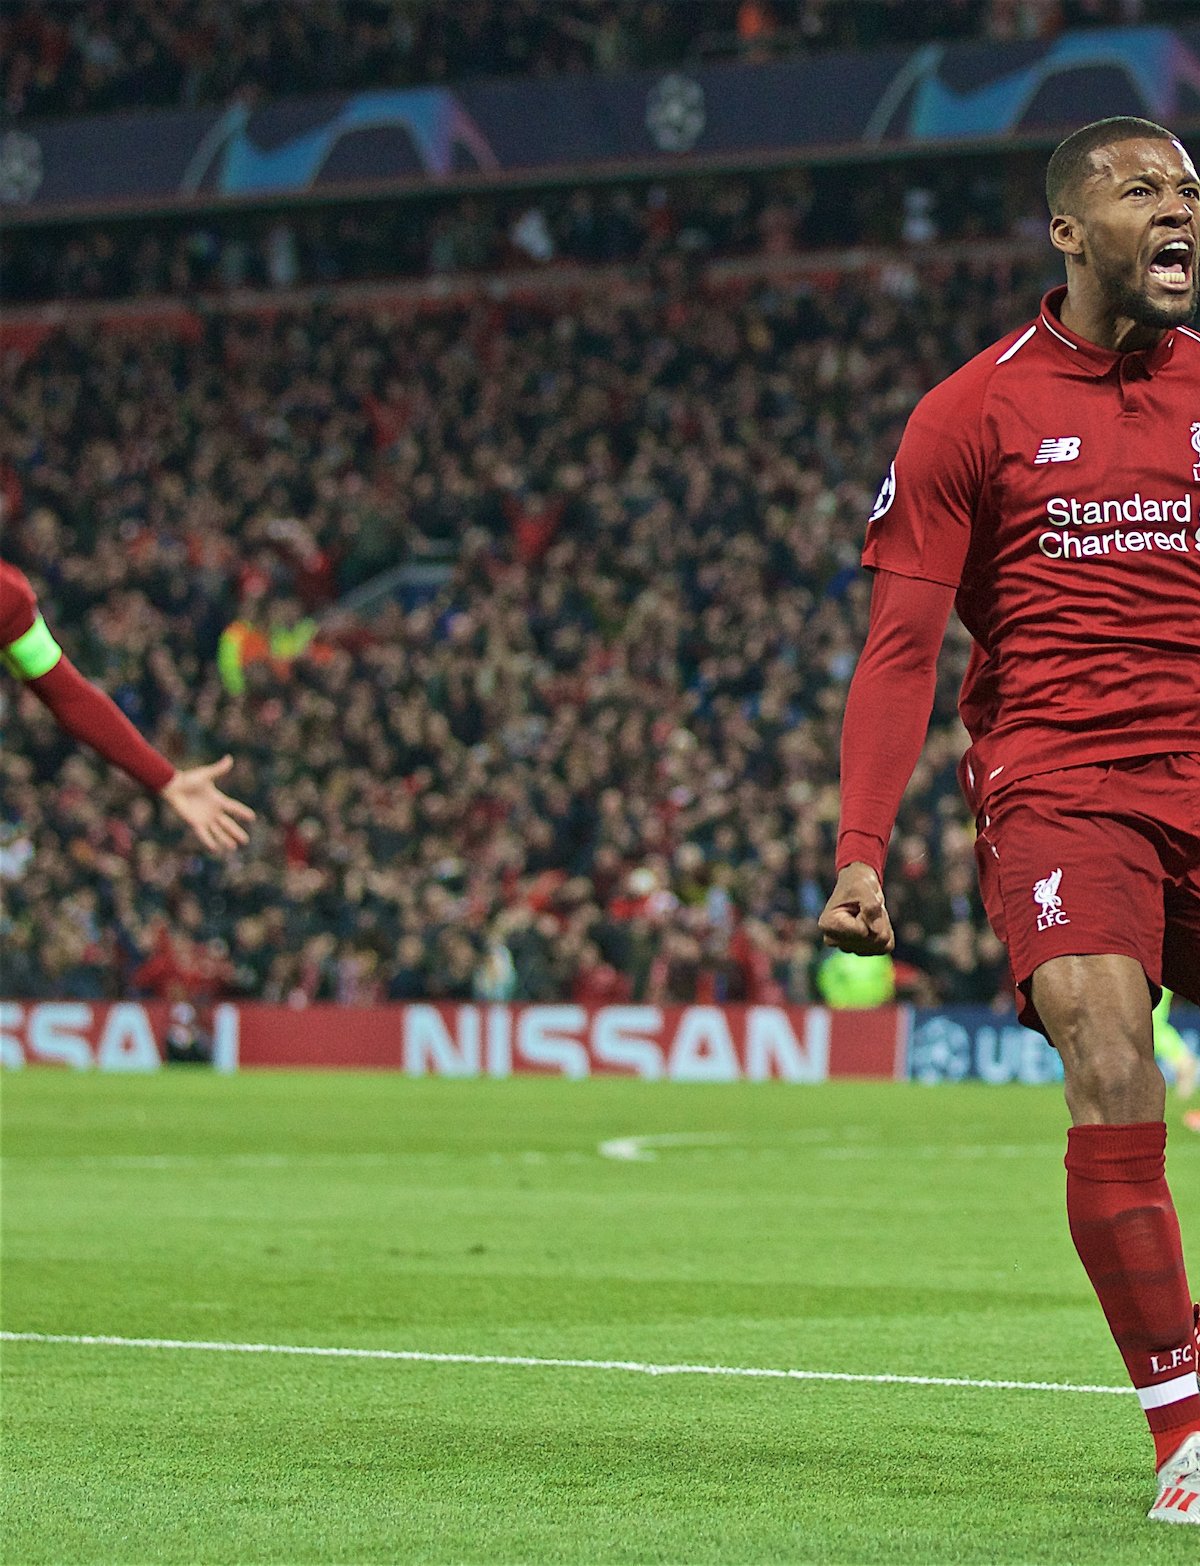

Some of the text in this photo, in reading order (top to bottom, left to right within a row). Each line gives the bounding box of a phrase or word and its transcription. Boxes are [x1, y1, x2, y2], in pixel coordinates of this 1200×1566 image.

[1046, 493, 1191, 526] Standard
[1038, 529, 1189, 559] Chartered
[402, 1003, 831, 1084] NISSAN
